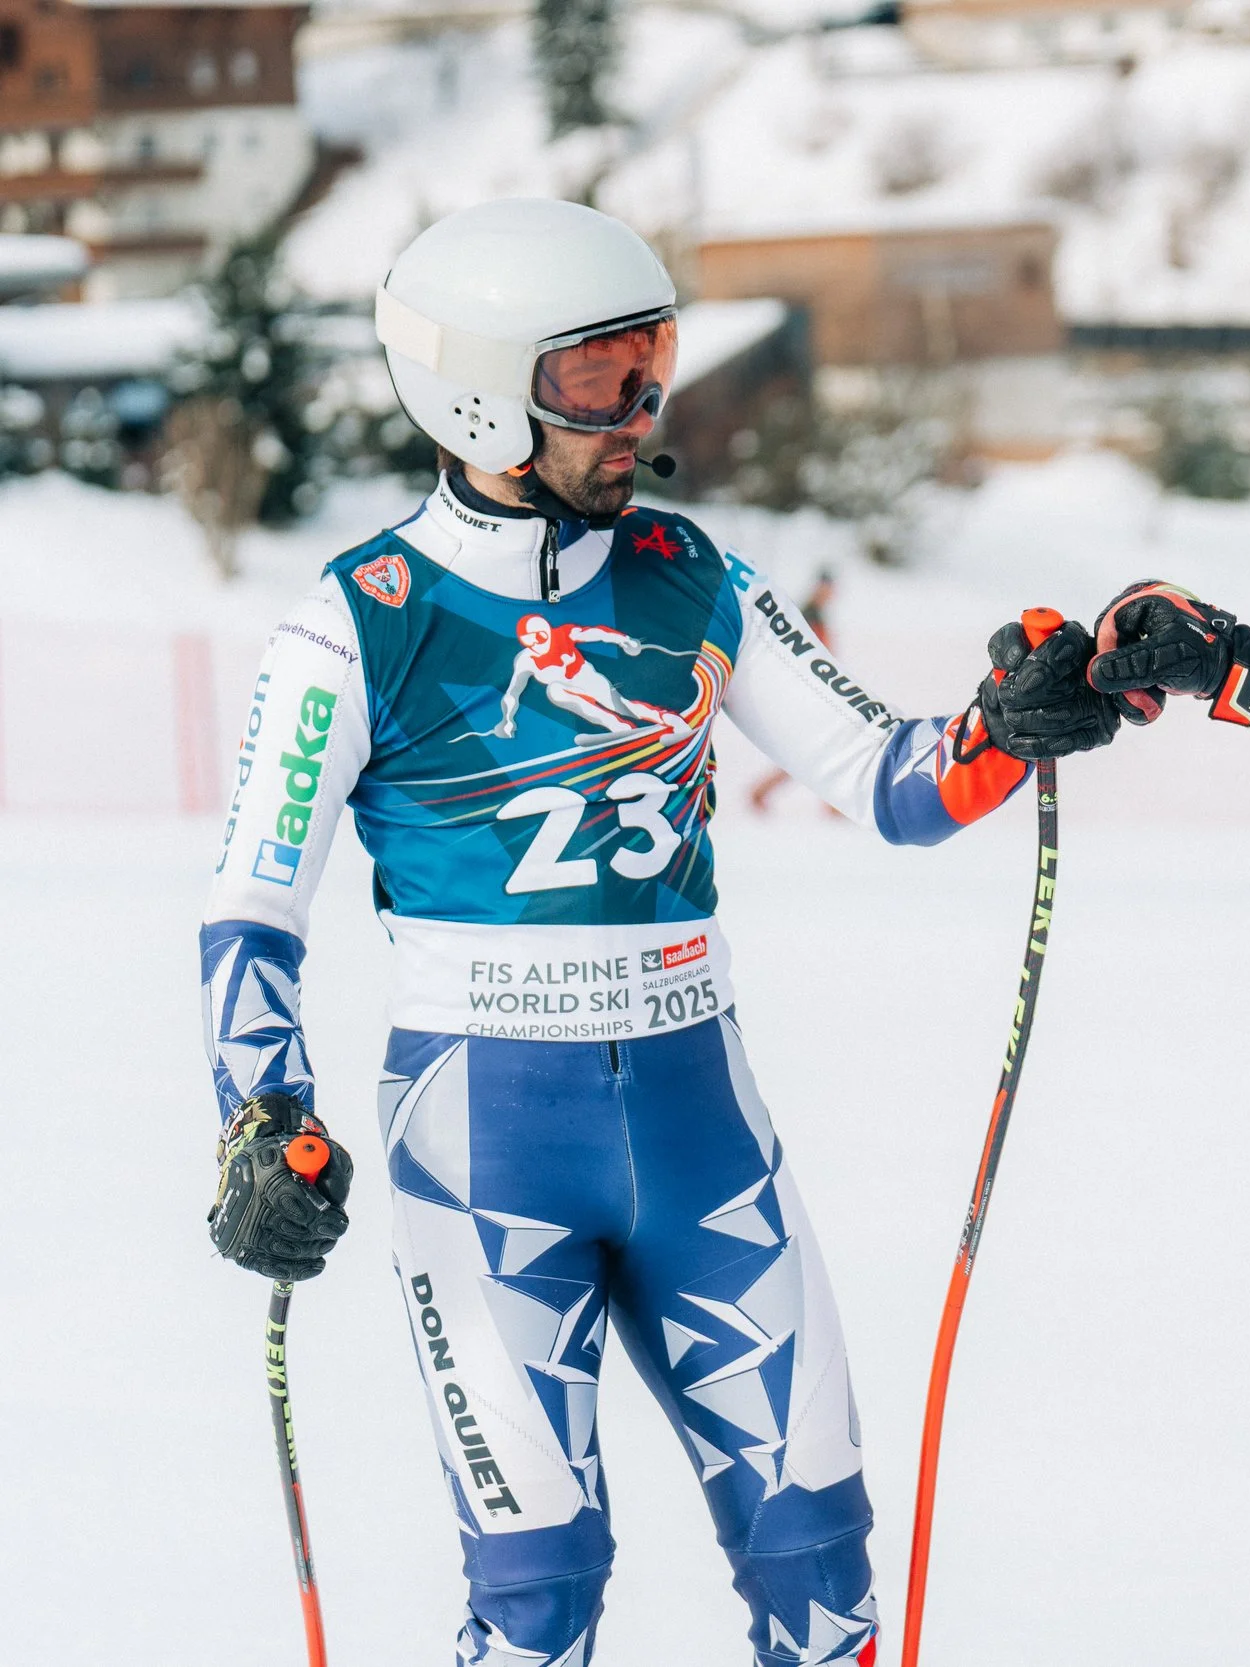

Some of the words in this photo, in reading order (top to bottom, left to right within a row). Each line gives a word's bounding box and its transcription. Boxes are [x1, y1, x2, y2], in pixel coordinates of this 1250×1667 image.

[455, 509, 502, 532] QUIET
[754, 590, 815, 657] DON
[215, 672, 271, 875] cardion
[251, 685, 338, 887] radka
[496, 772, 682, 895] 23
[1030, 845, 1058, 955] LEKI
[471, 960, 513, 984] FIS
[522, 956, 629, 985] ALPINE
[642, 963, 711, 991] SALZBURGERLAND
[665, 935, 706, 965] saalbach
[465, 1019, 634, 1039] CHAMPIONSHIPS
[468, 991, 580, 1014] WORLD
[589, 987, 630, 1012] SKI
[643, 978, 719, 1029] 2025
[265, 1316, 288, 1397] LEKI
[410, 1272, 456, 1372] DON
[443, 1382, 523, 1515] QUIET
